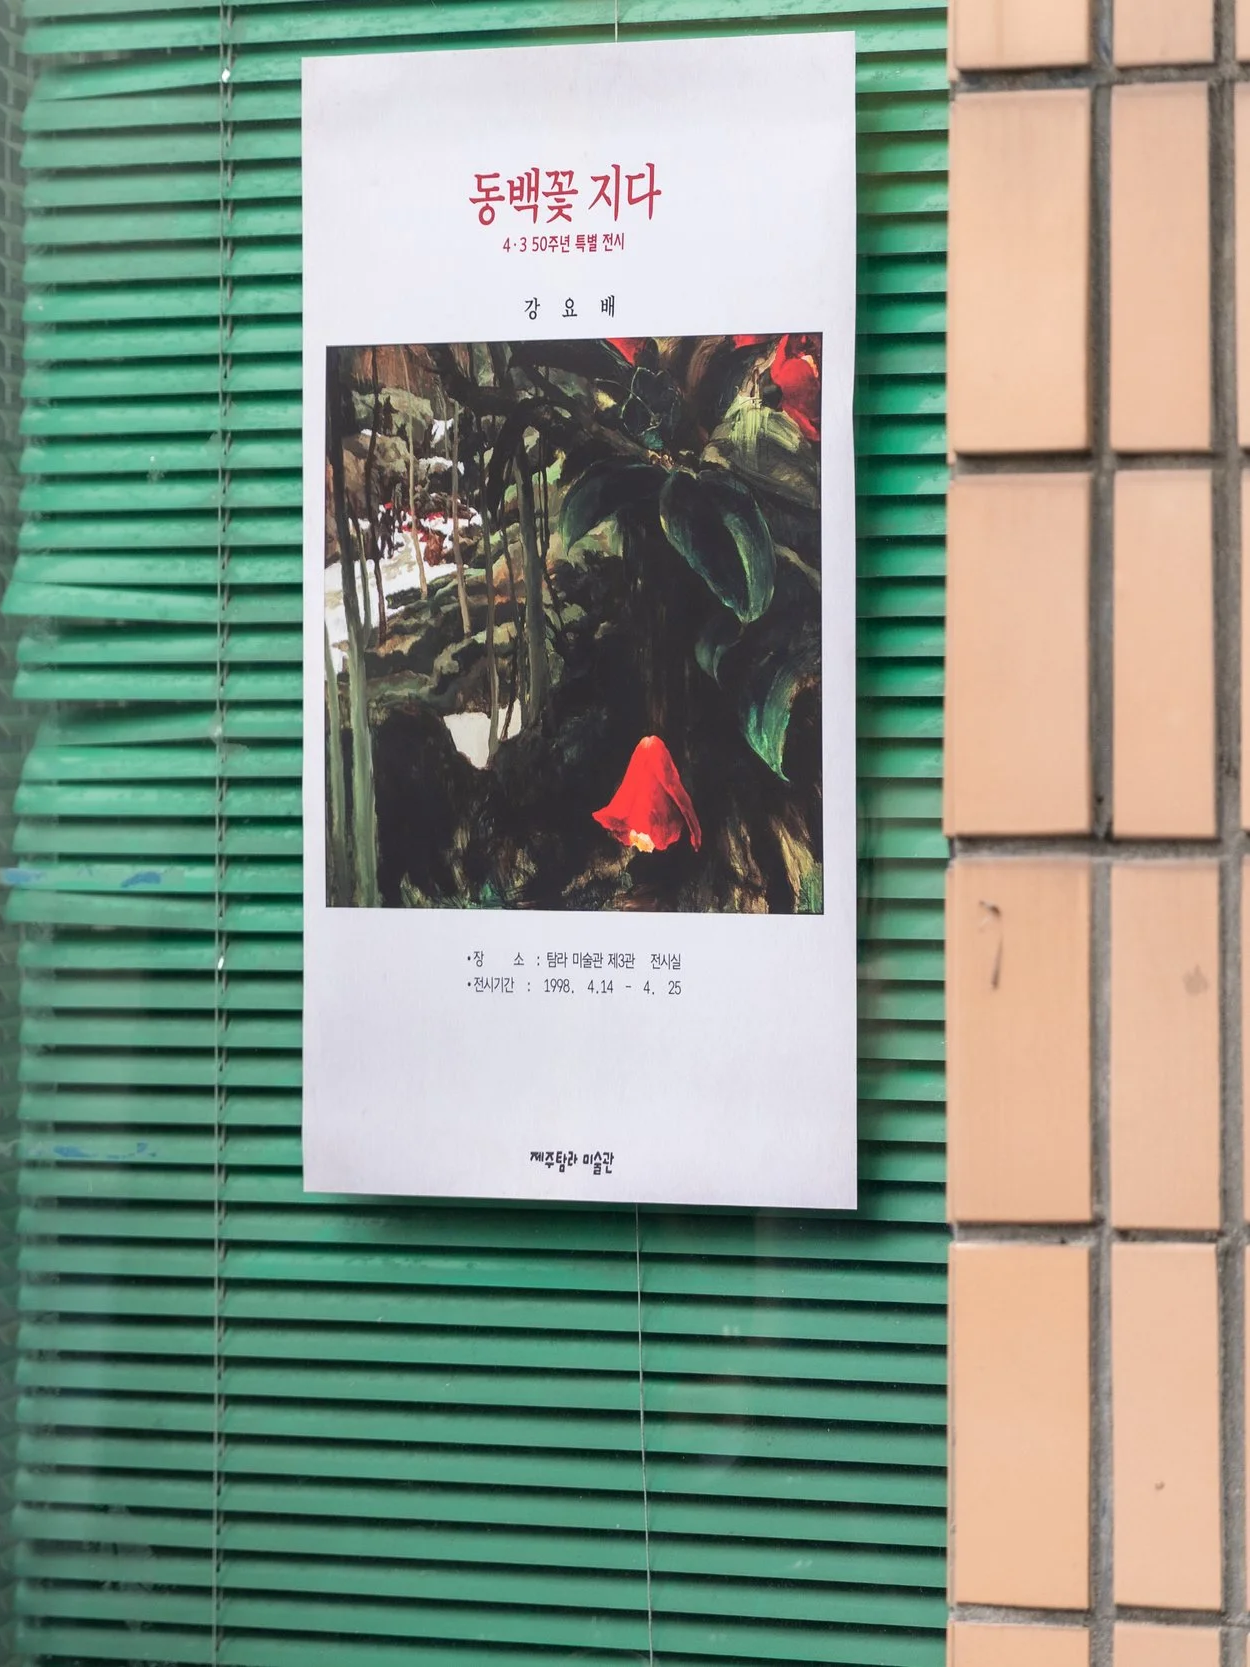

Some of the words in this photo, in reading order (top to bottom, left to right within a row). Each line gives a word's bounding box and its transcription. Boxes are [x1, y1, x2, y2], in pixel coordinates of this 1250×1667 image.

[468, 166, 579, 226] 동백꽃
[587, 162, 662, 222] 지다
[531, 234, 571, 254] 50주년
[574, 233, 598, 253] 특별
[602, 232, 625, 252] 전시
[546, 951, 569, 969] 탐라
[572, 951, 604, 969] 미술관
[607, 952, 636, 970] 제3관
[650, 952, 681, 971] 전시실
[543, 978, 575, 995] 1998.
[668, 980, 682, 996] 25
[529, 1150, 579, 1174] 제주탐라
[582, 1150, 615, 1176] 미술관
